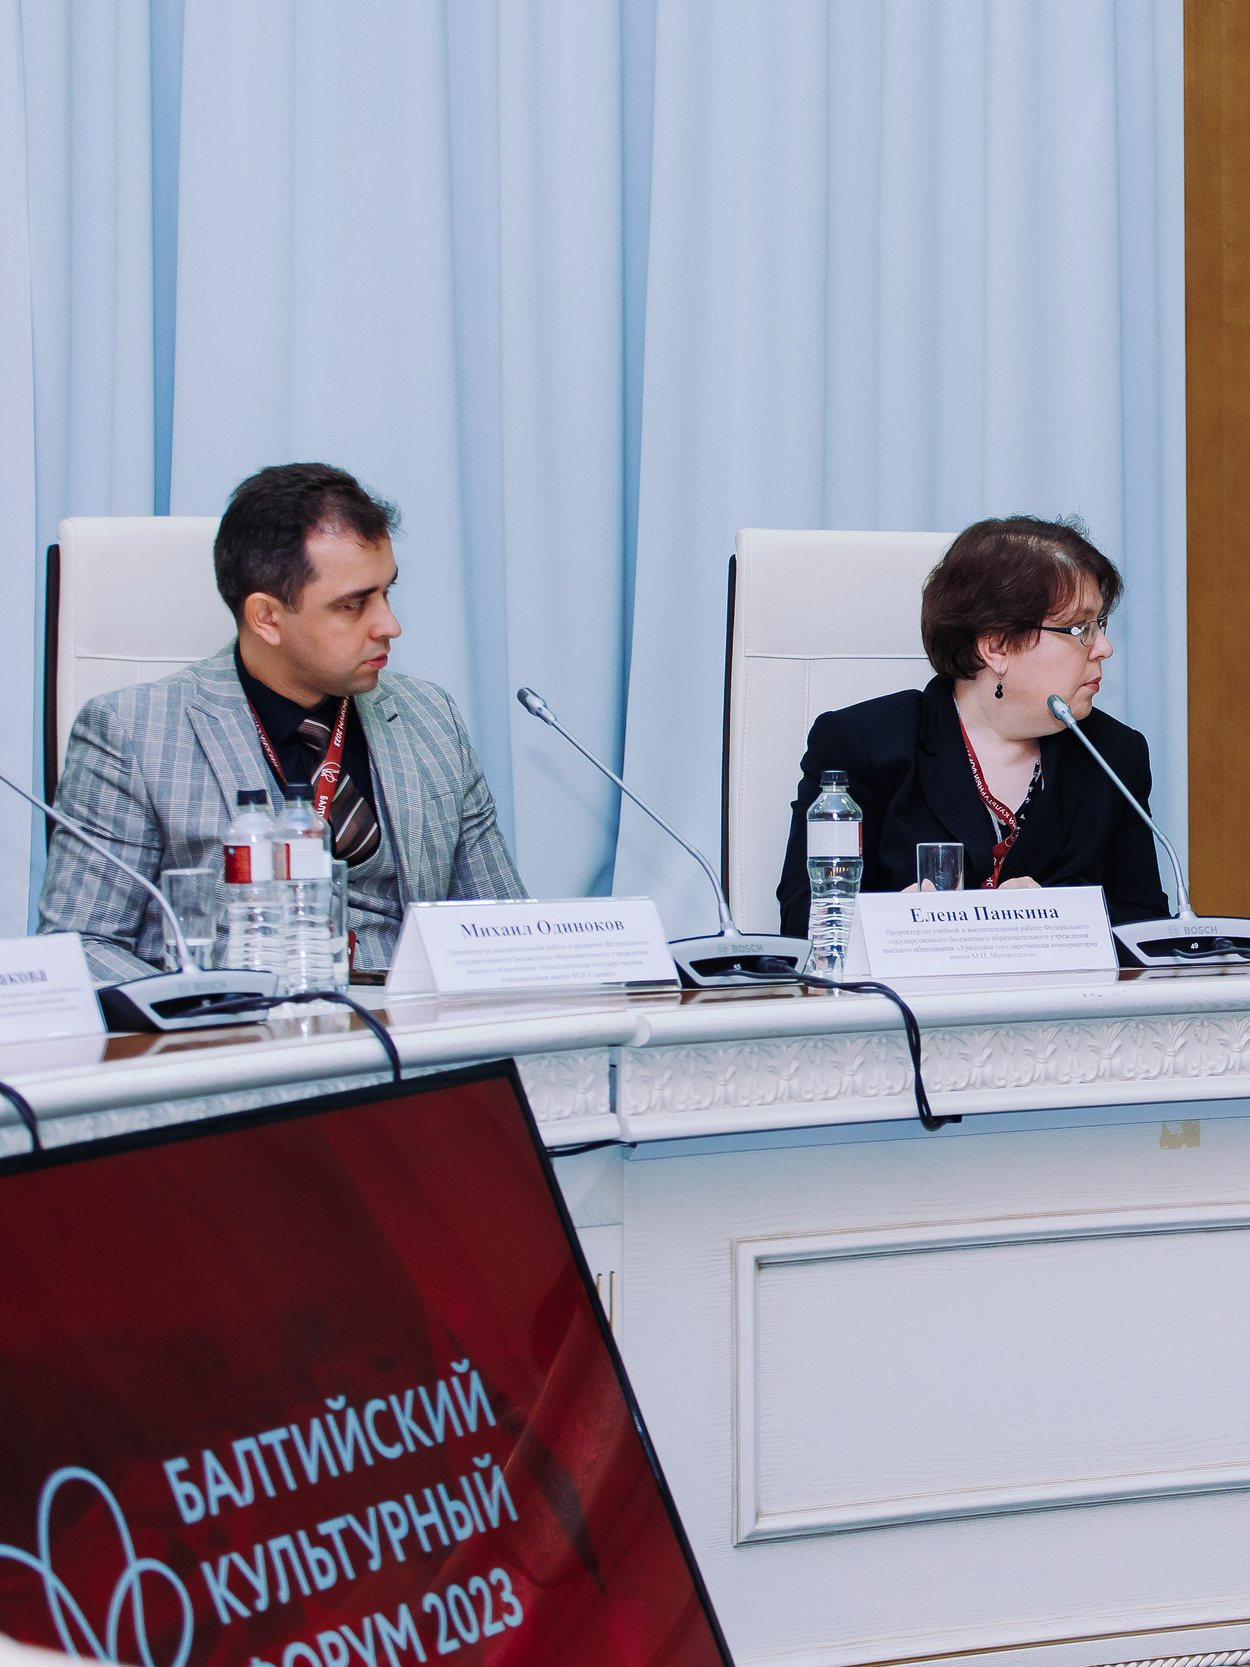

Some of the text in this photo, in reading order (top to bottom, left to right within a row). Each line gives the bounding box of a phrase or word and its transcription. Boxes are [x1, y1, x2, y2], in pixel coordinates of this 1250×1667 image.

[333, 728, 343, 748] 2023
[316, 795, 329, 818] БАЛТ
[910, 905, 1059, 923] Елена Панкина
[461, 919, 625, 938] Михаил Одиноков
[885, 928, 921, 936] Проректор
[1020, 924, 1042, 933] работе
[949, 935, 990, 943] бюджетного
[1050, 932, 1089, 941] учреждения
[1183, 926, 1218, 935] BOSCH
[731, 944, 764, 953] BOSCH
[163, 1356, 497, 1525] БАЛТИЙСКИЙ
[199, 1451, 519, 1625] КУЛЬТУРНЫЙ
[248, 1567, 524, 1667] ОРУМ 2023
